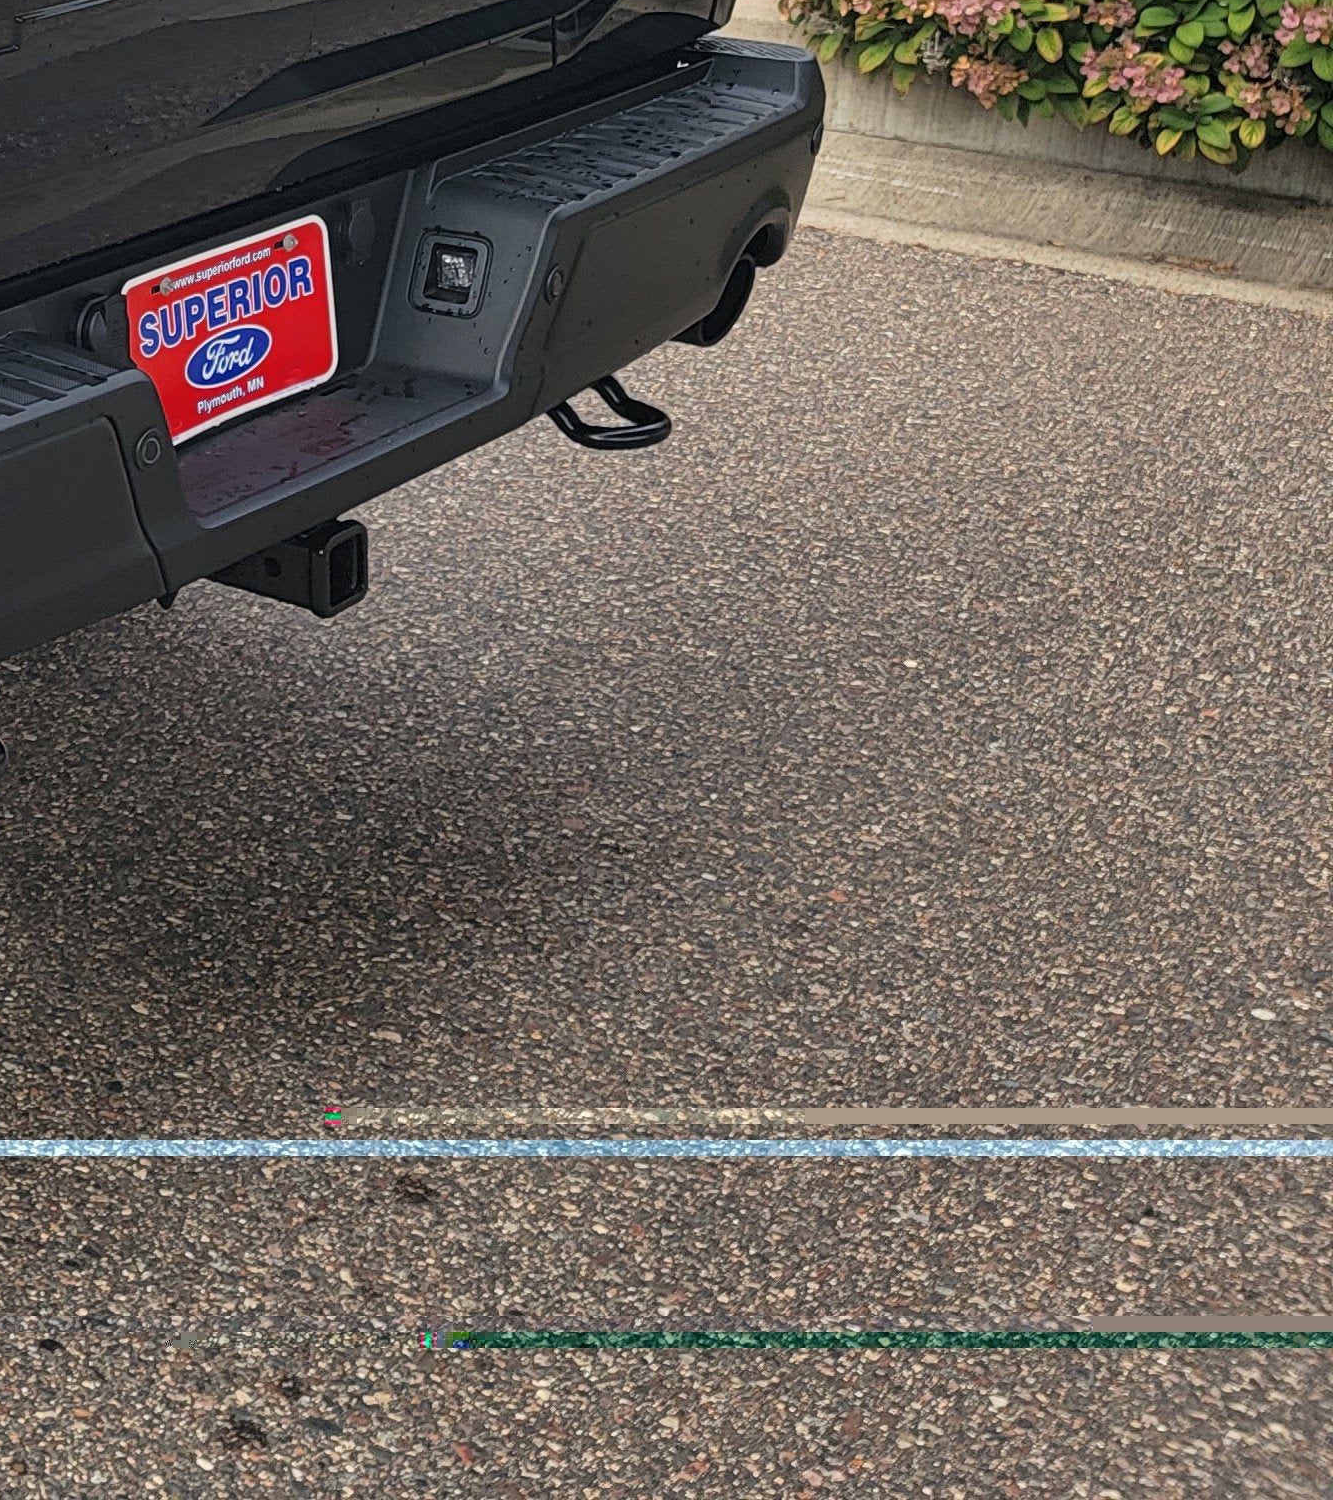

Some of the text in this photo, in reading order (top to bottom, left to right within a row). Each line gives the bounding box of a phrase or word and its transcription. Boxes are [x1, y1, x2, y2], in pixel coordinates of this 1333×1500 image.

[172, 247, 271, 290] www.superiorford.com
[139, 255, 314, 358] SUPERIOR
[201, 334, 255, 380] Ford
[196, 376, 264, 414] Plymouth, MN
